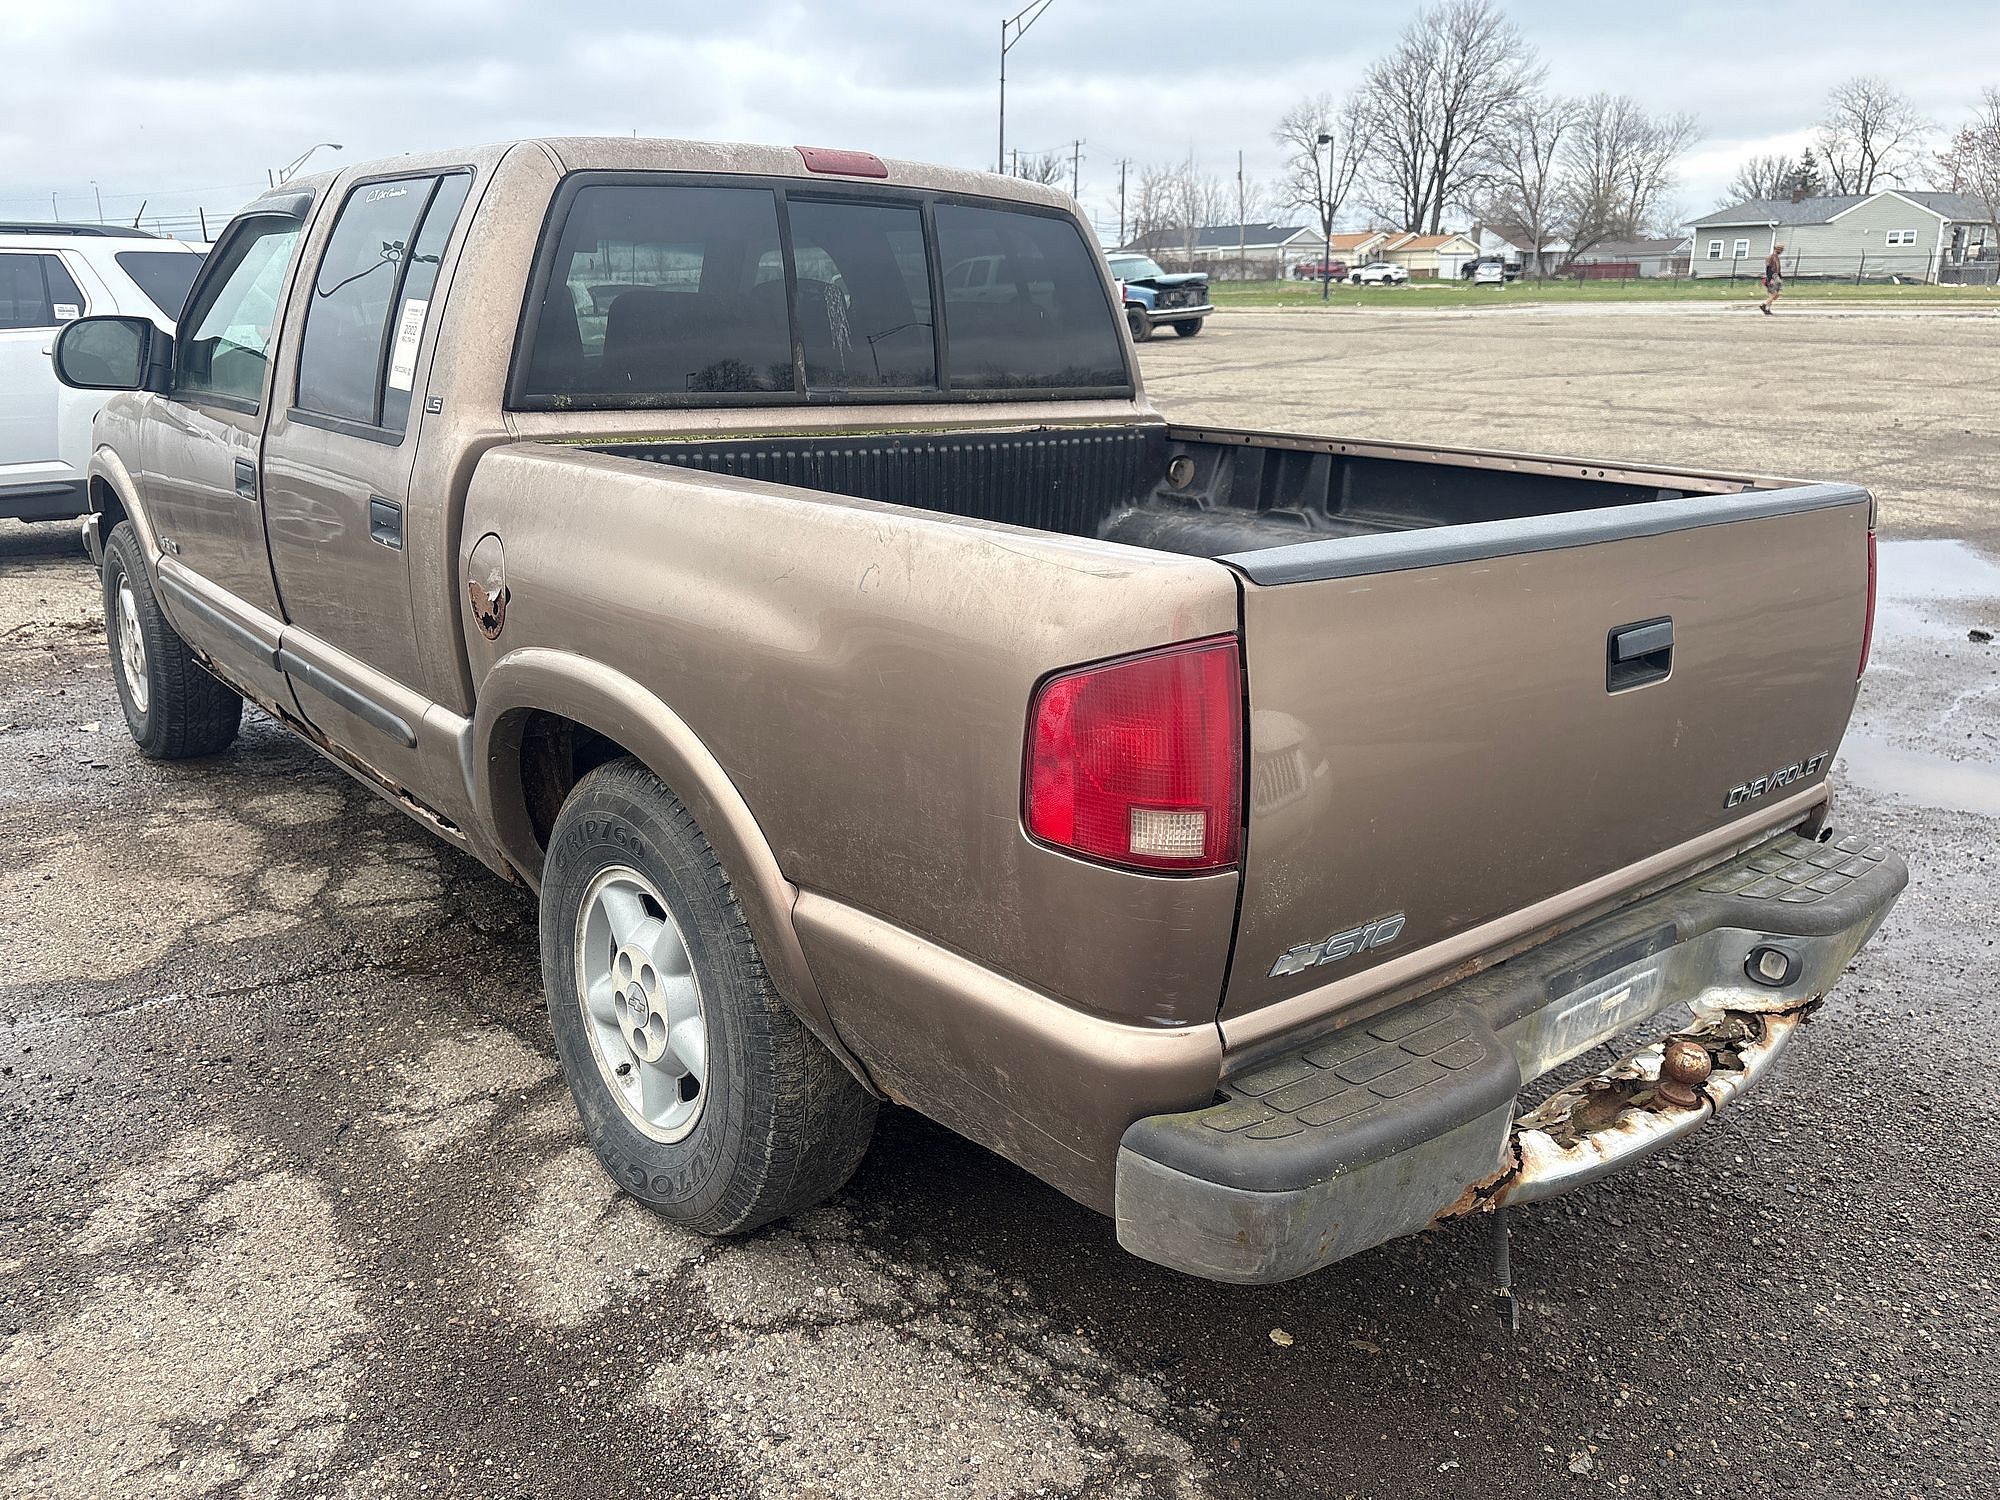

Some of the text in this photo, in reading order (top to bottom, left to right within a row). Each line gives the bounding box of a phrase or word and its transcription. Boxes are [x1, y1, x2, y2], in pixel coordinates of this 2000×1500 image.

[426, 399, 442, 412] LS
[1723, 750, 1829, 808] CHEVROLET
[1320, 911, 1406, 966] S10
